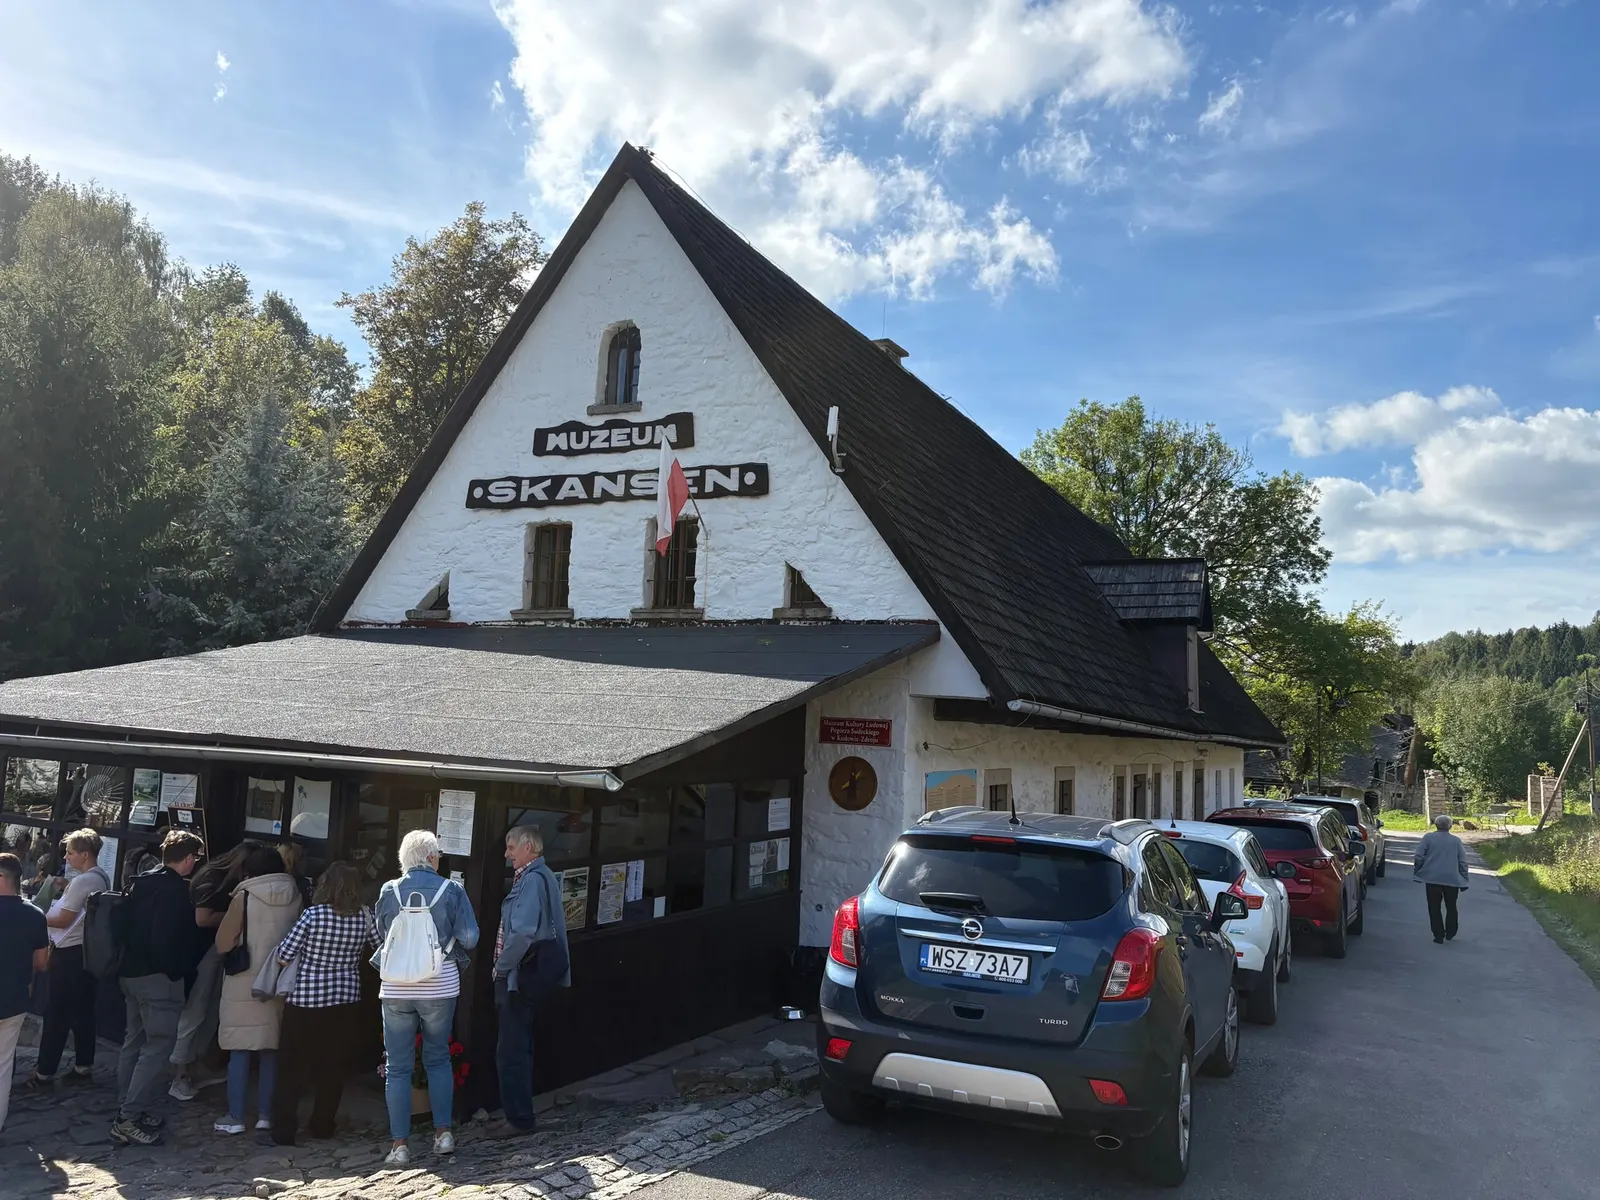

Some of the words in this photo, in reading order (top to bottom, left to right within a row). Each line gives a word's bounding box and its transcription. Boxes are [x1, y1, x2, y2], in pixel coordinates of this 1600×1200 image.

[546, 423, 678, 451] MUZEUM
[845, 720, 864, 728] Kultury
[866, 722, 888, 730] Ludowej
[932, 947, 968, 970] WSZ
[975, 953, 1024, 976] 73A7
[880, 994, 905, 1003] MOKKA
[1039, 1018, 1069, 1026] TURBO
